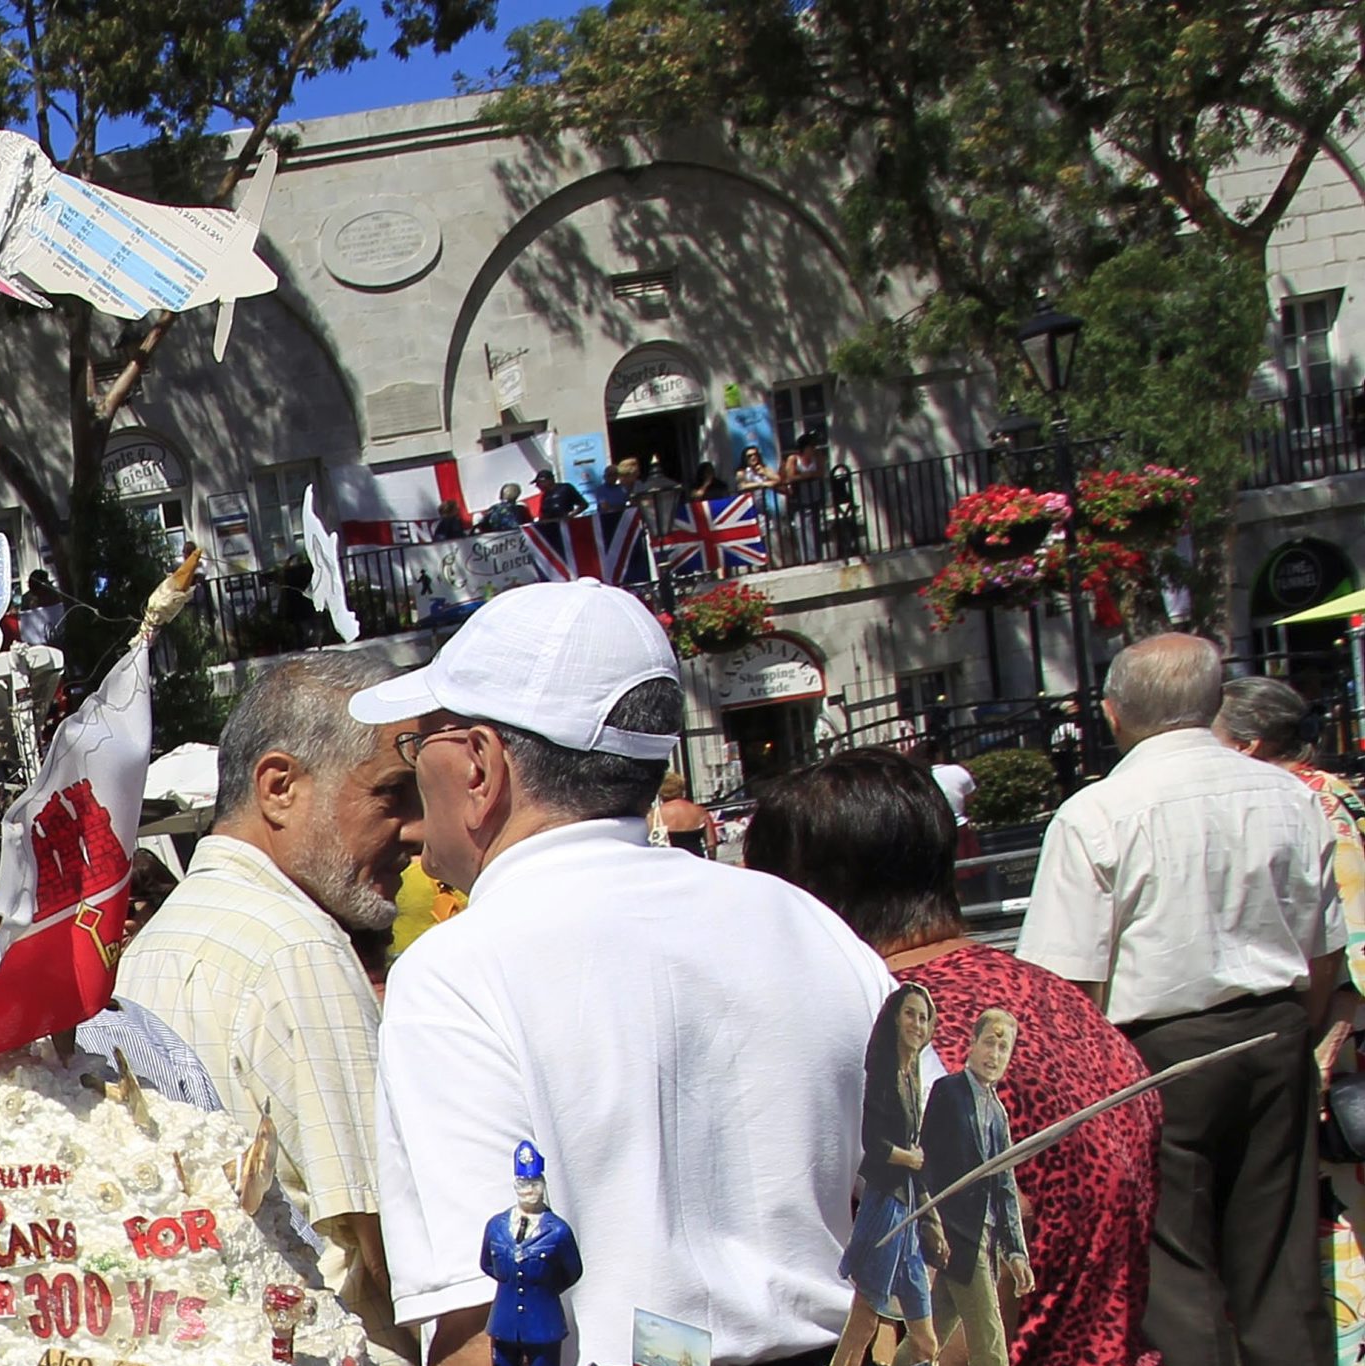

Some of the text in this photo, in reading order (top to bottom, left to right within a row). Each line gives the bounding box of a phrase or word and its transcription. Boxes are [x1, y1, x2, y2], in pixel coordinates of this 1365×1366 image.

[471, 539, 517, 562] Sports
[739, 667, 796, 684] Shopping
[748, 683, 790, 697] Arcade
[123, 1208, 222, 1260] FOR
[24, 1272, 113, 1339] 300
